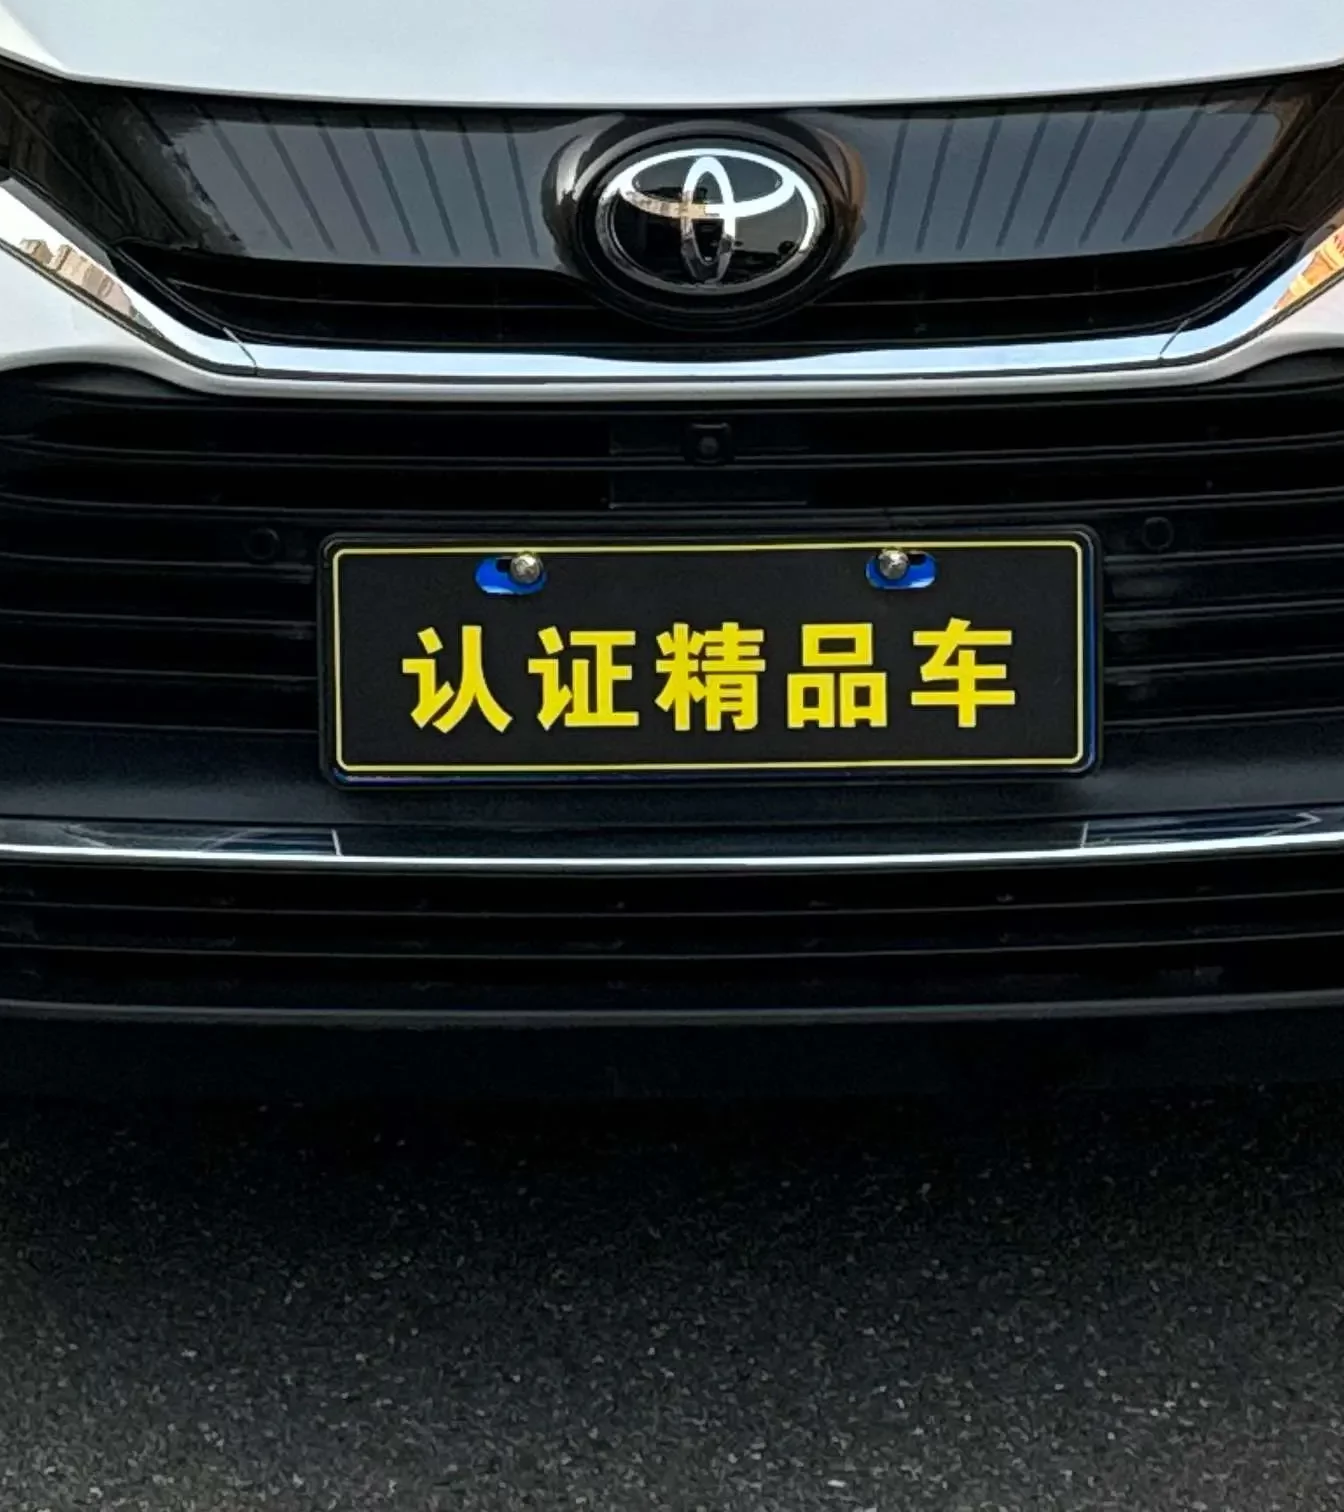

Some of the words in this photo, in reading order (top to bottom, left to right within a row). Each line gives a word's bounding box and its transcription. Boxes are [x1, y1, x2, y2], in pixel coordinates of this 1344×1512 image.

[401, 618, 1017, 734] 认证精品车
